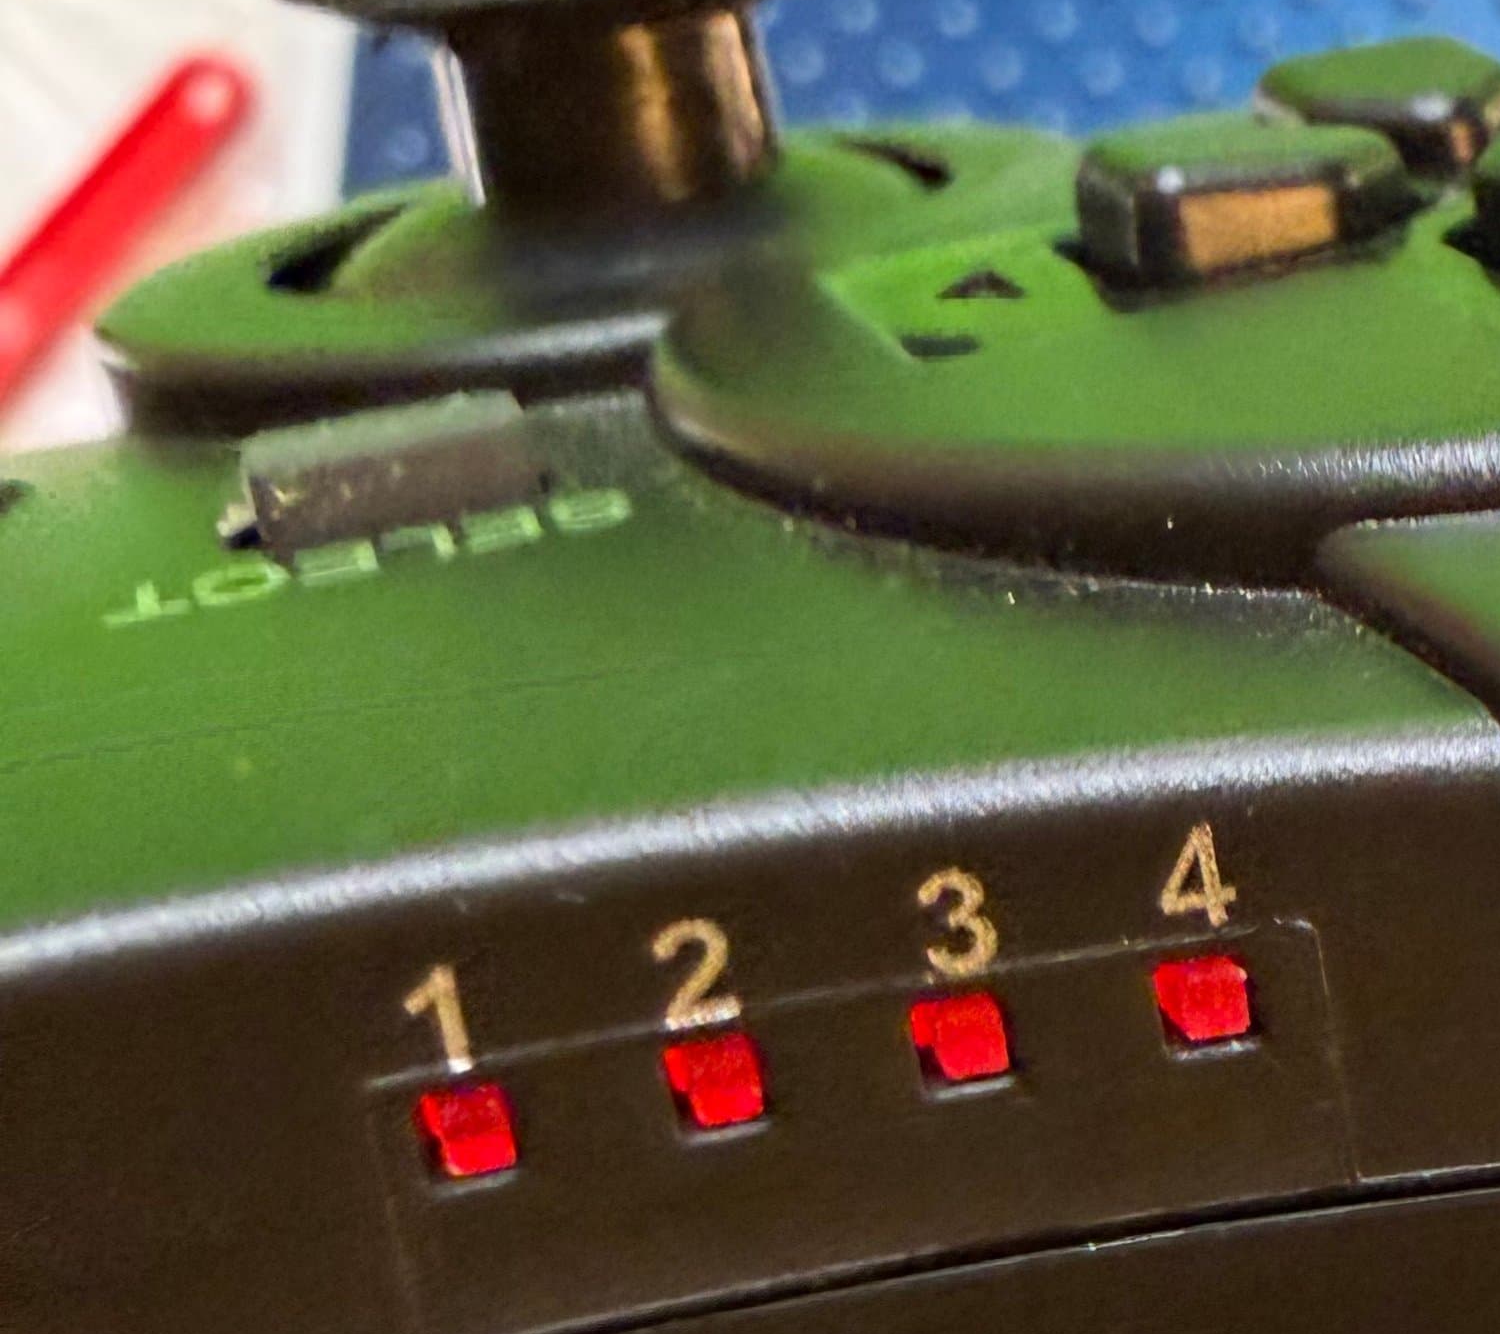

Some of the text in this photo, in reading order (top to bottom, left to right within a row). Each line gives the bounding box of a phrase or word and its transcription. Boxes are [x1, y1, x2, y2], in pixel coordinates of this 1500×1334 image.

[102, 487, 633, 629] SELECT
[404, 822, 1238, 1073] 1 2 3 4
